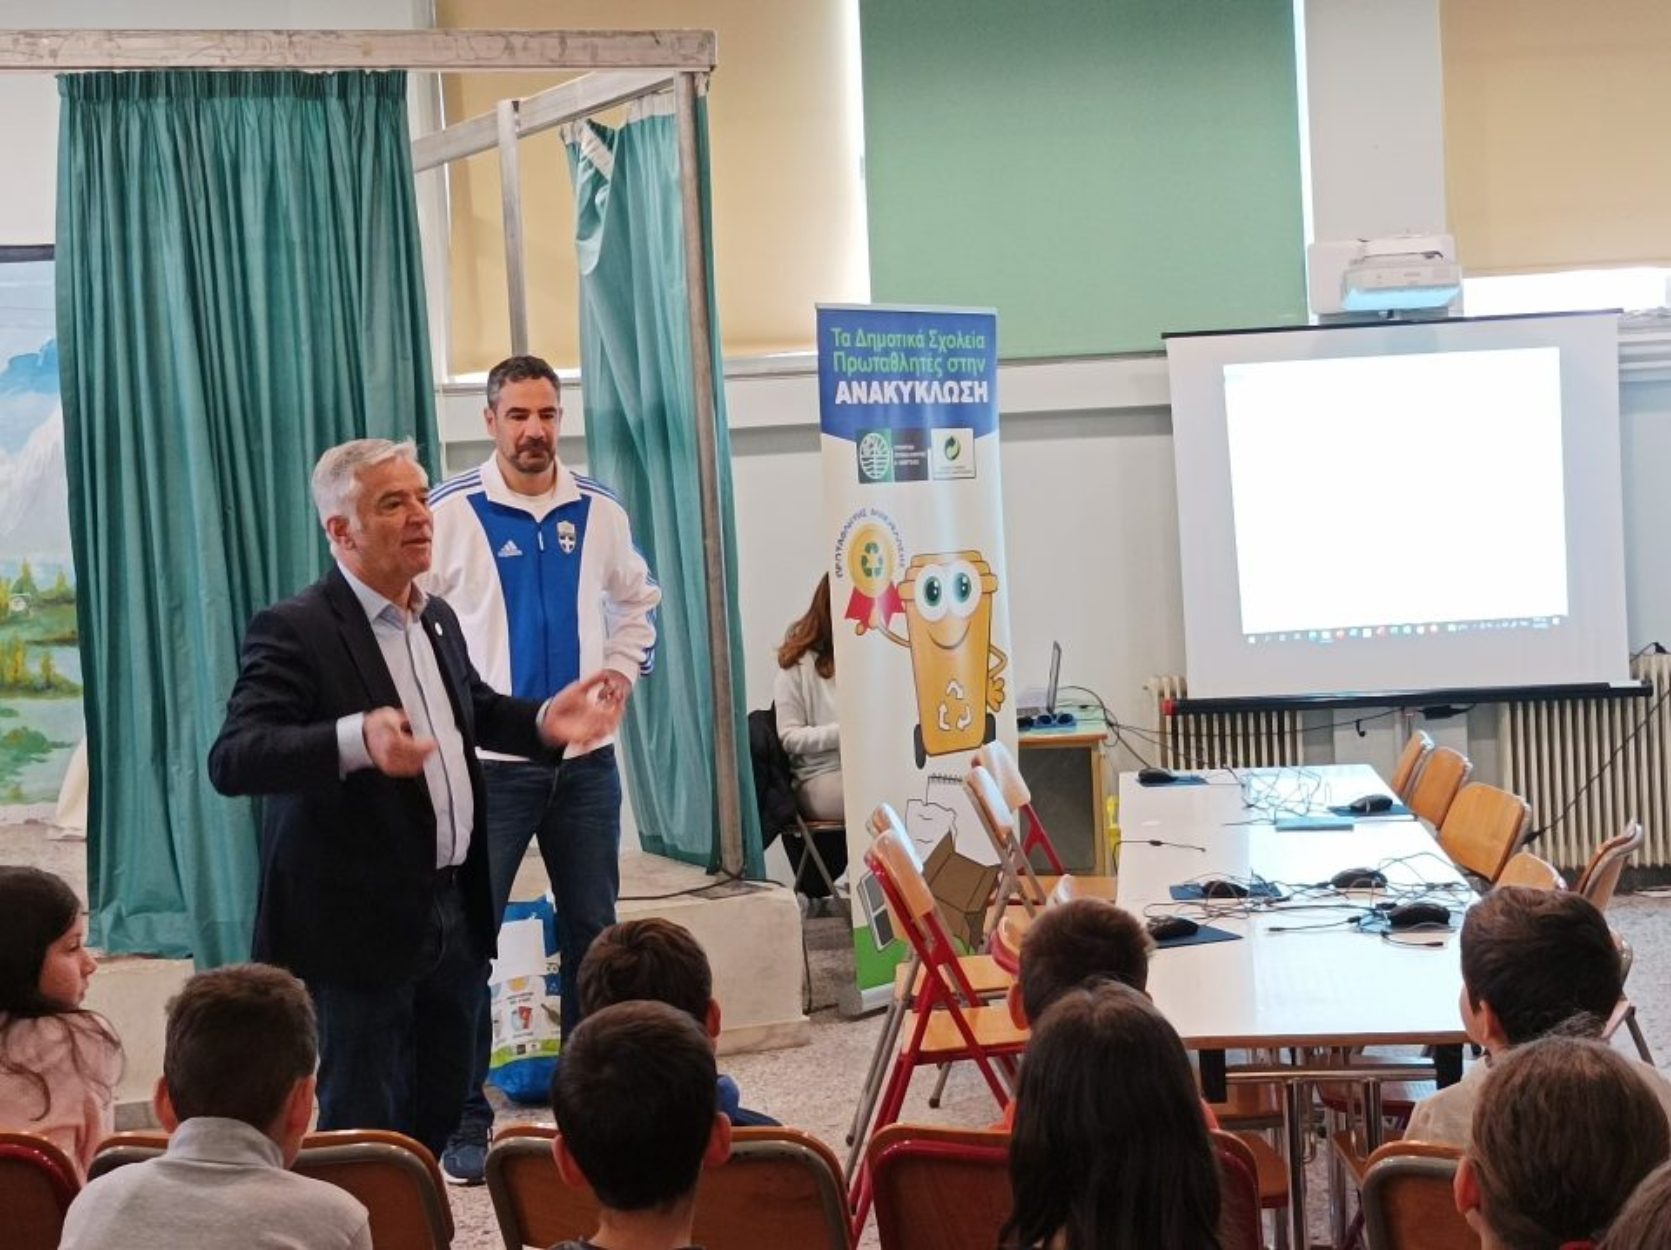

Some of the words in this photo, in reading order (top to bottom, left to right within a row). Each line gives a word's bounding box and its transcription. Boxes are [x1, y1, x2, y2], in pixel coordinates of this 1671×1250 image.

[831, 328, 851, 347] Τα
[855, 328, 924, 352] Δημοτικά
[929, 329, 985, 353] Σχολεία
[833, 351, 942, 377] Πρωταθλητές
[947, 356, 986, 377] στην
[835, 380, 989, 404] ΑΝΑΚΥΚΛΩΣΗ
